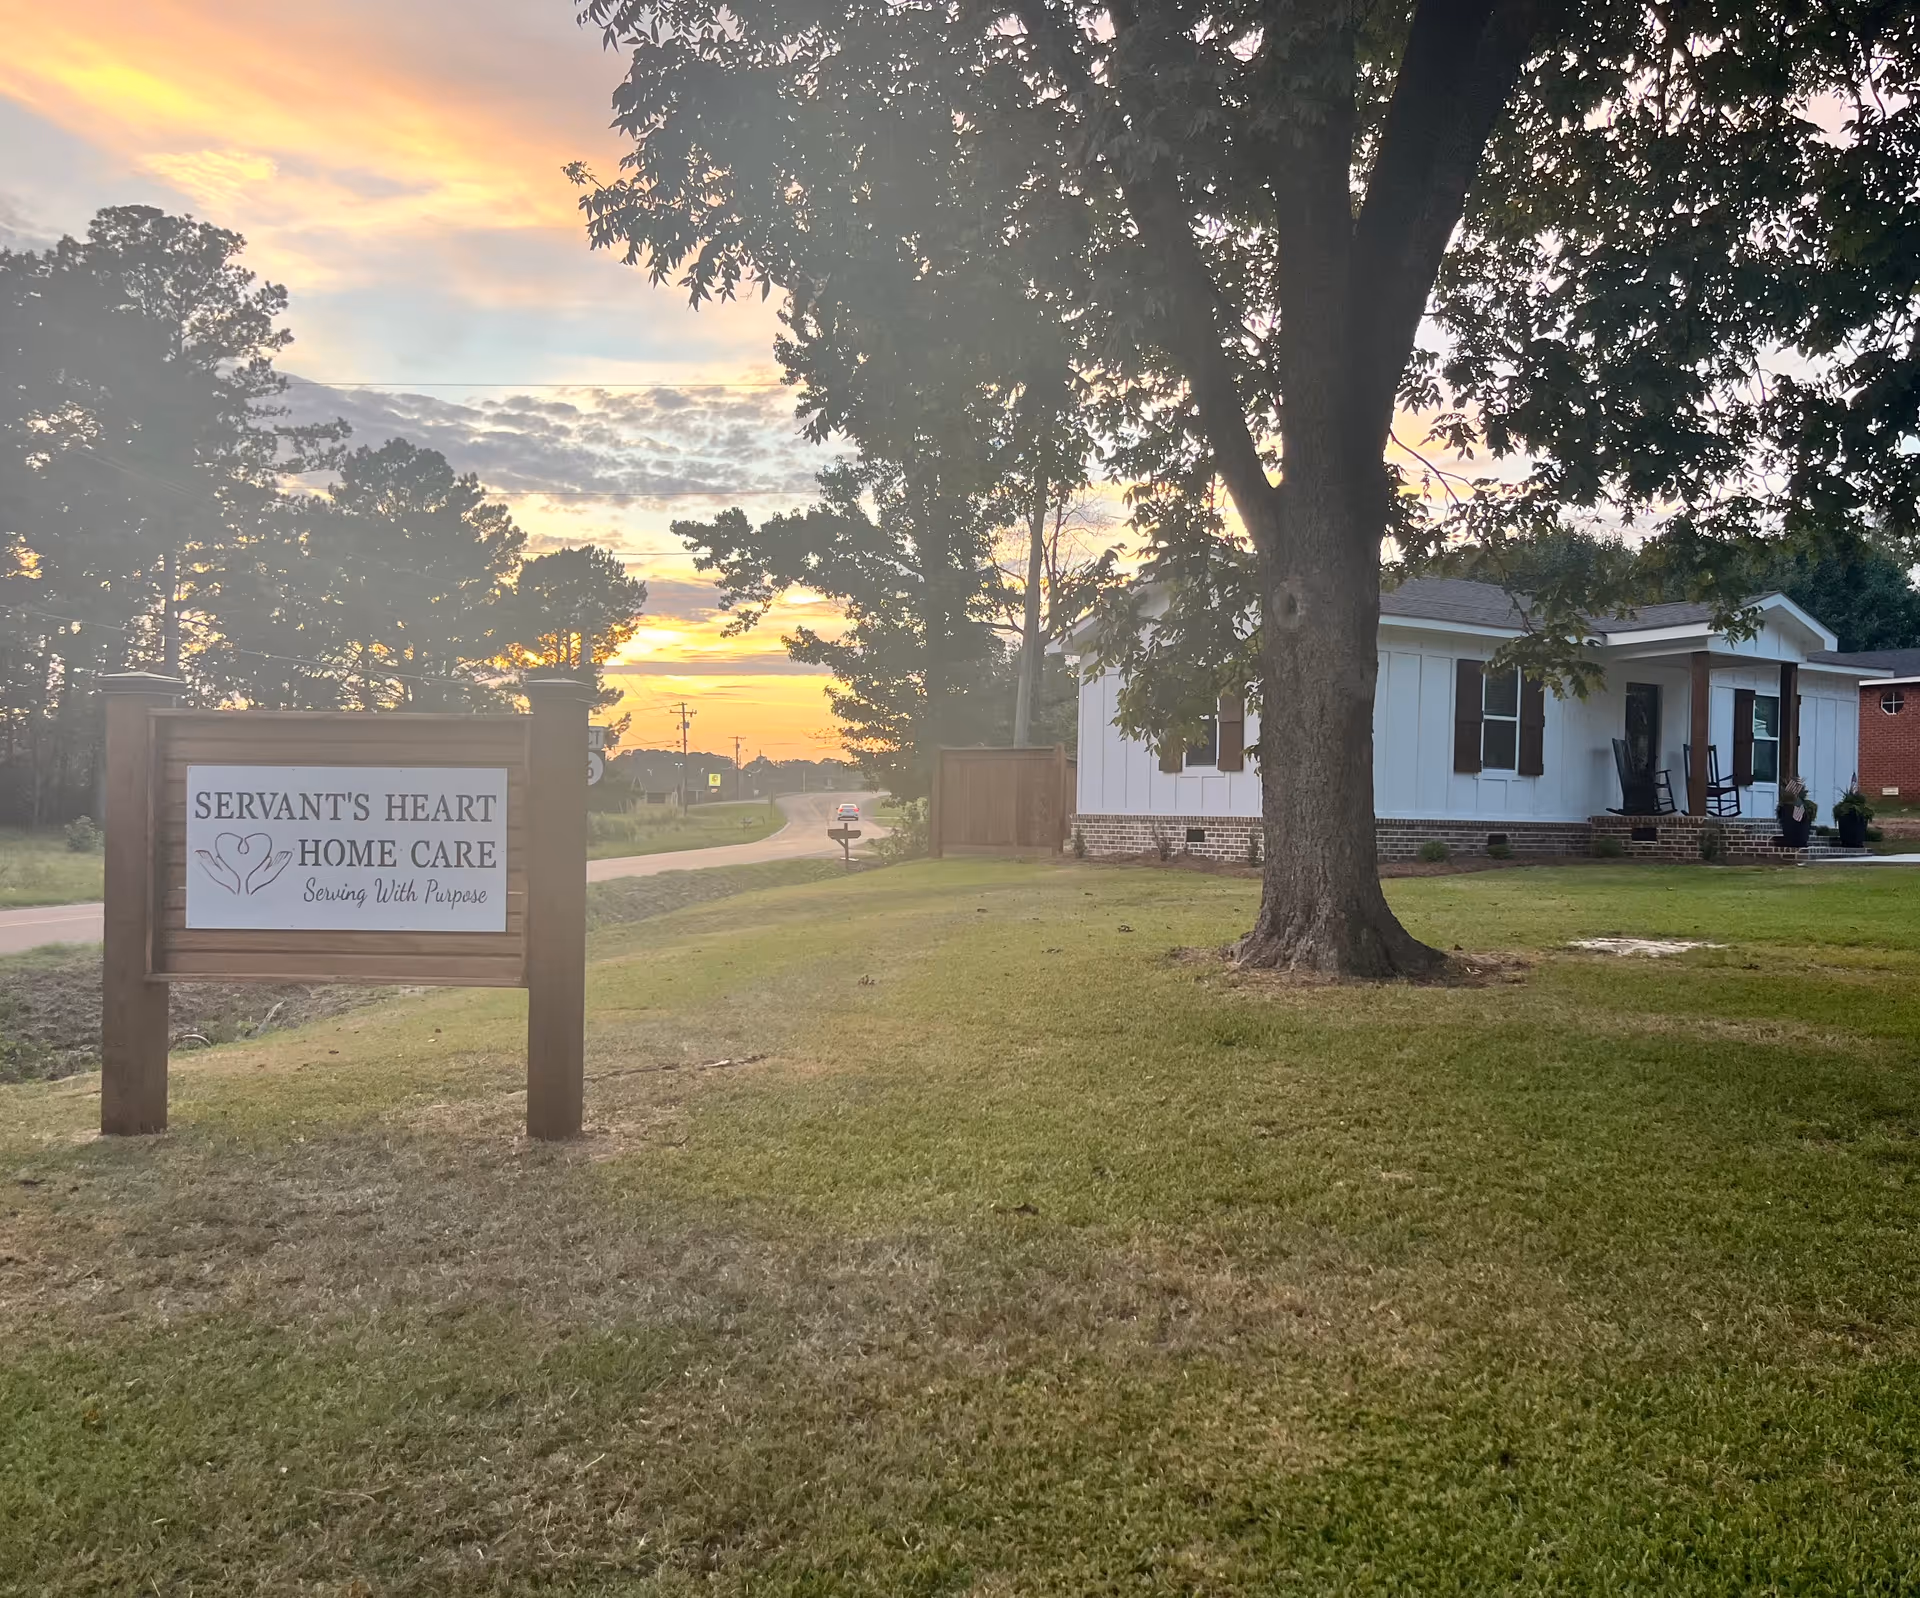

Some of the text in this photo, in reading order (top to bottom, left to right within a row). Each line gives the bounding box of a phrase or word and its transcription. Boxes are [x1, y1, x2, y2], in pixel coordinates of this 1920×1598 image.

[195, 791, 497, 823] SERVANT'S HEART
[297, 838, 497, 869] HOME CARE
[303, 876, 488, 910] Serving With Purpose
